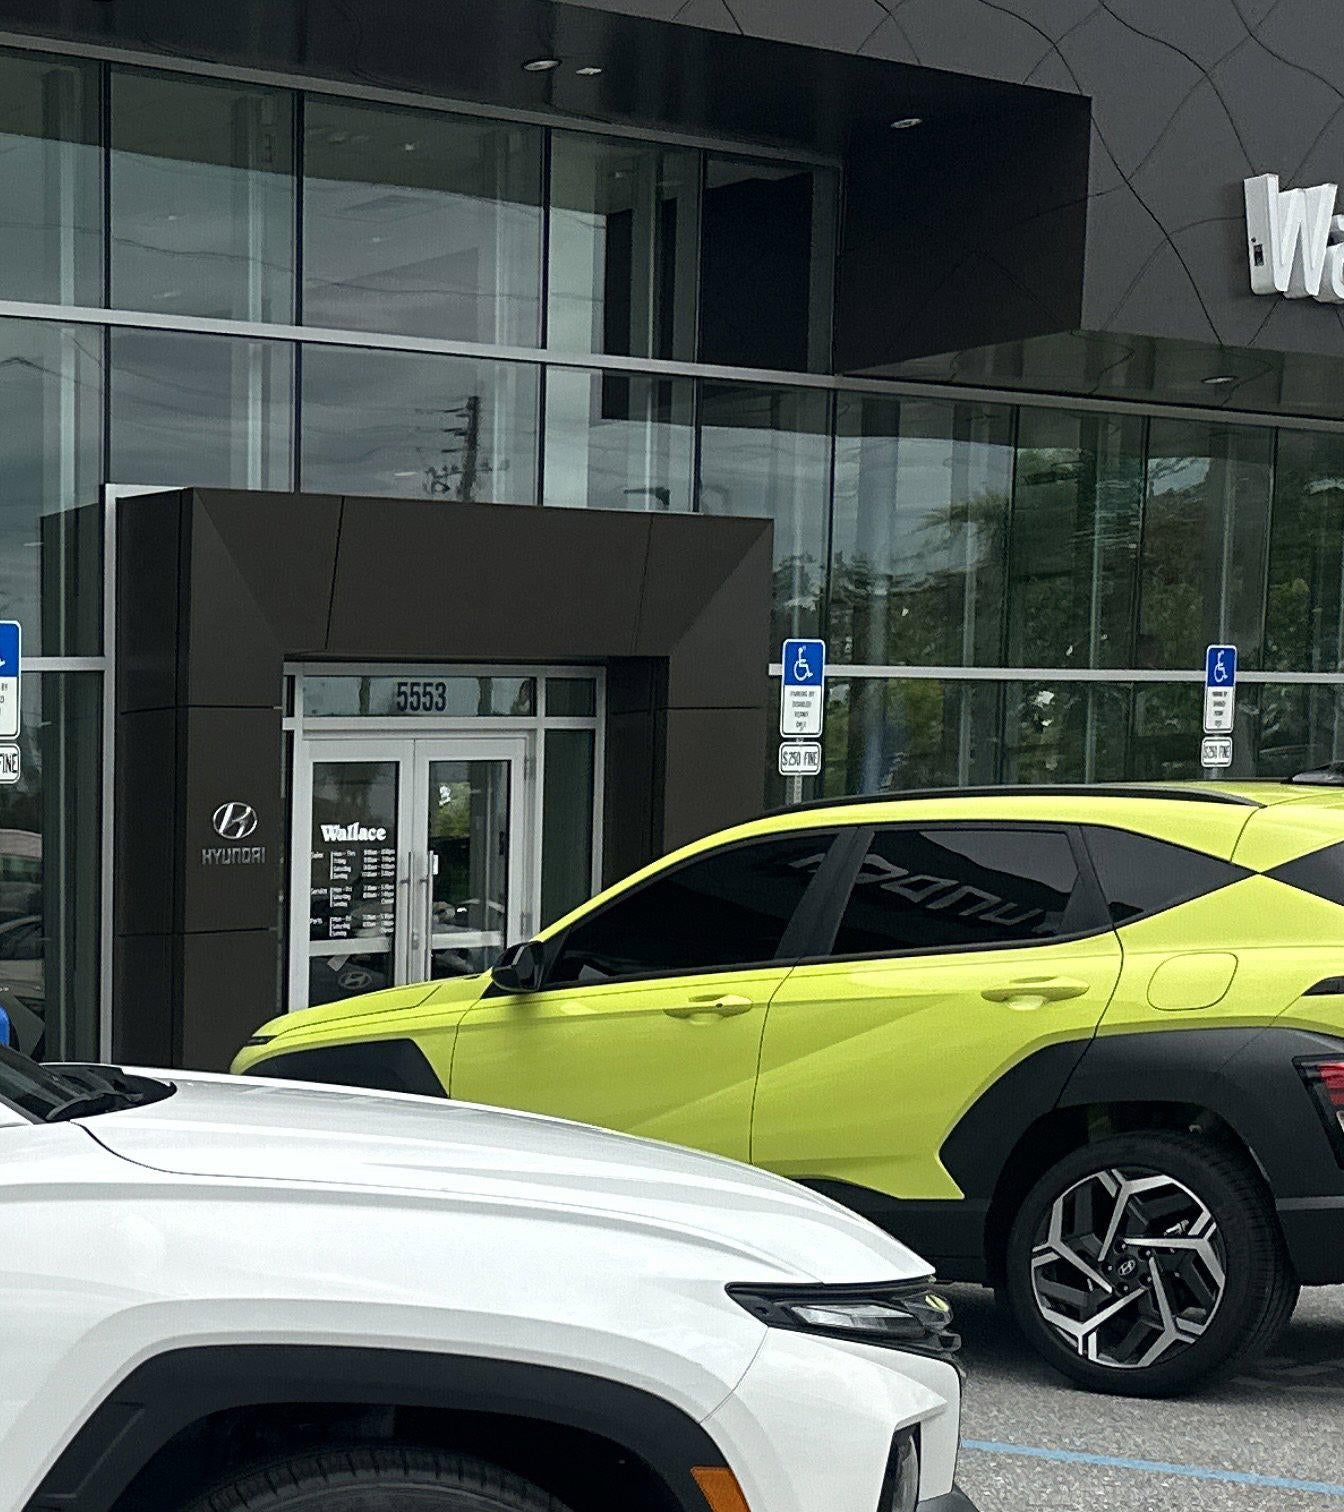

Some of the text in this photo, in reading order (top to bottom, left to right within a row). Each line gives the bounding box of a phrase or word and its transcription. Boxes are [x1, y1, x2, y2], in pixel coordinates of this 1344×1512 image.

[396, 681, 448, 712] 5553
[320, 822, 387, 842] Wallace
[201, 846, 267, 865] HYUNDAI
